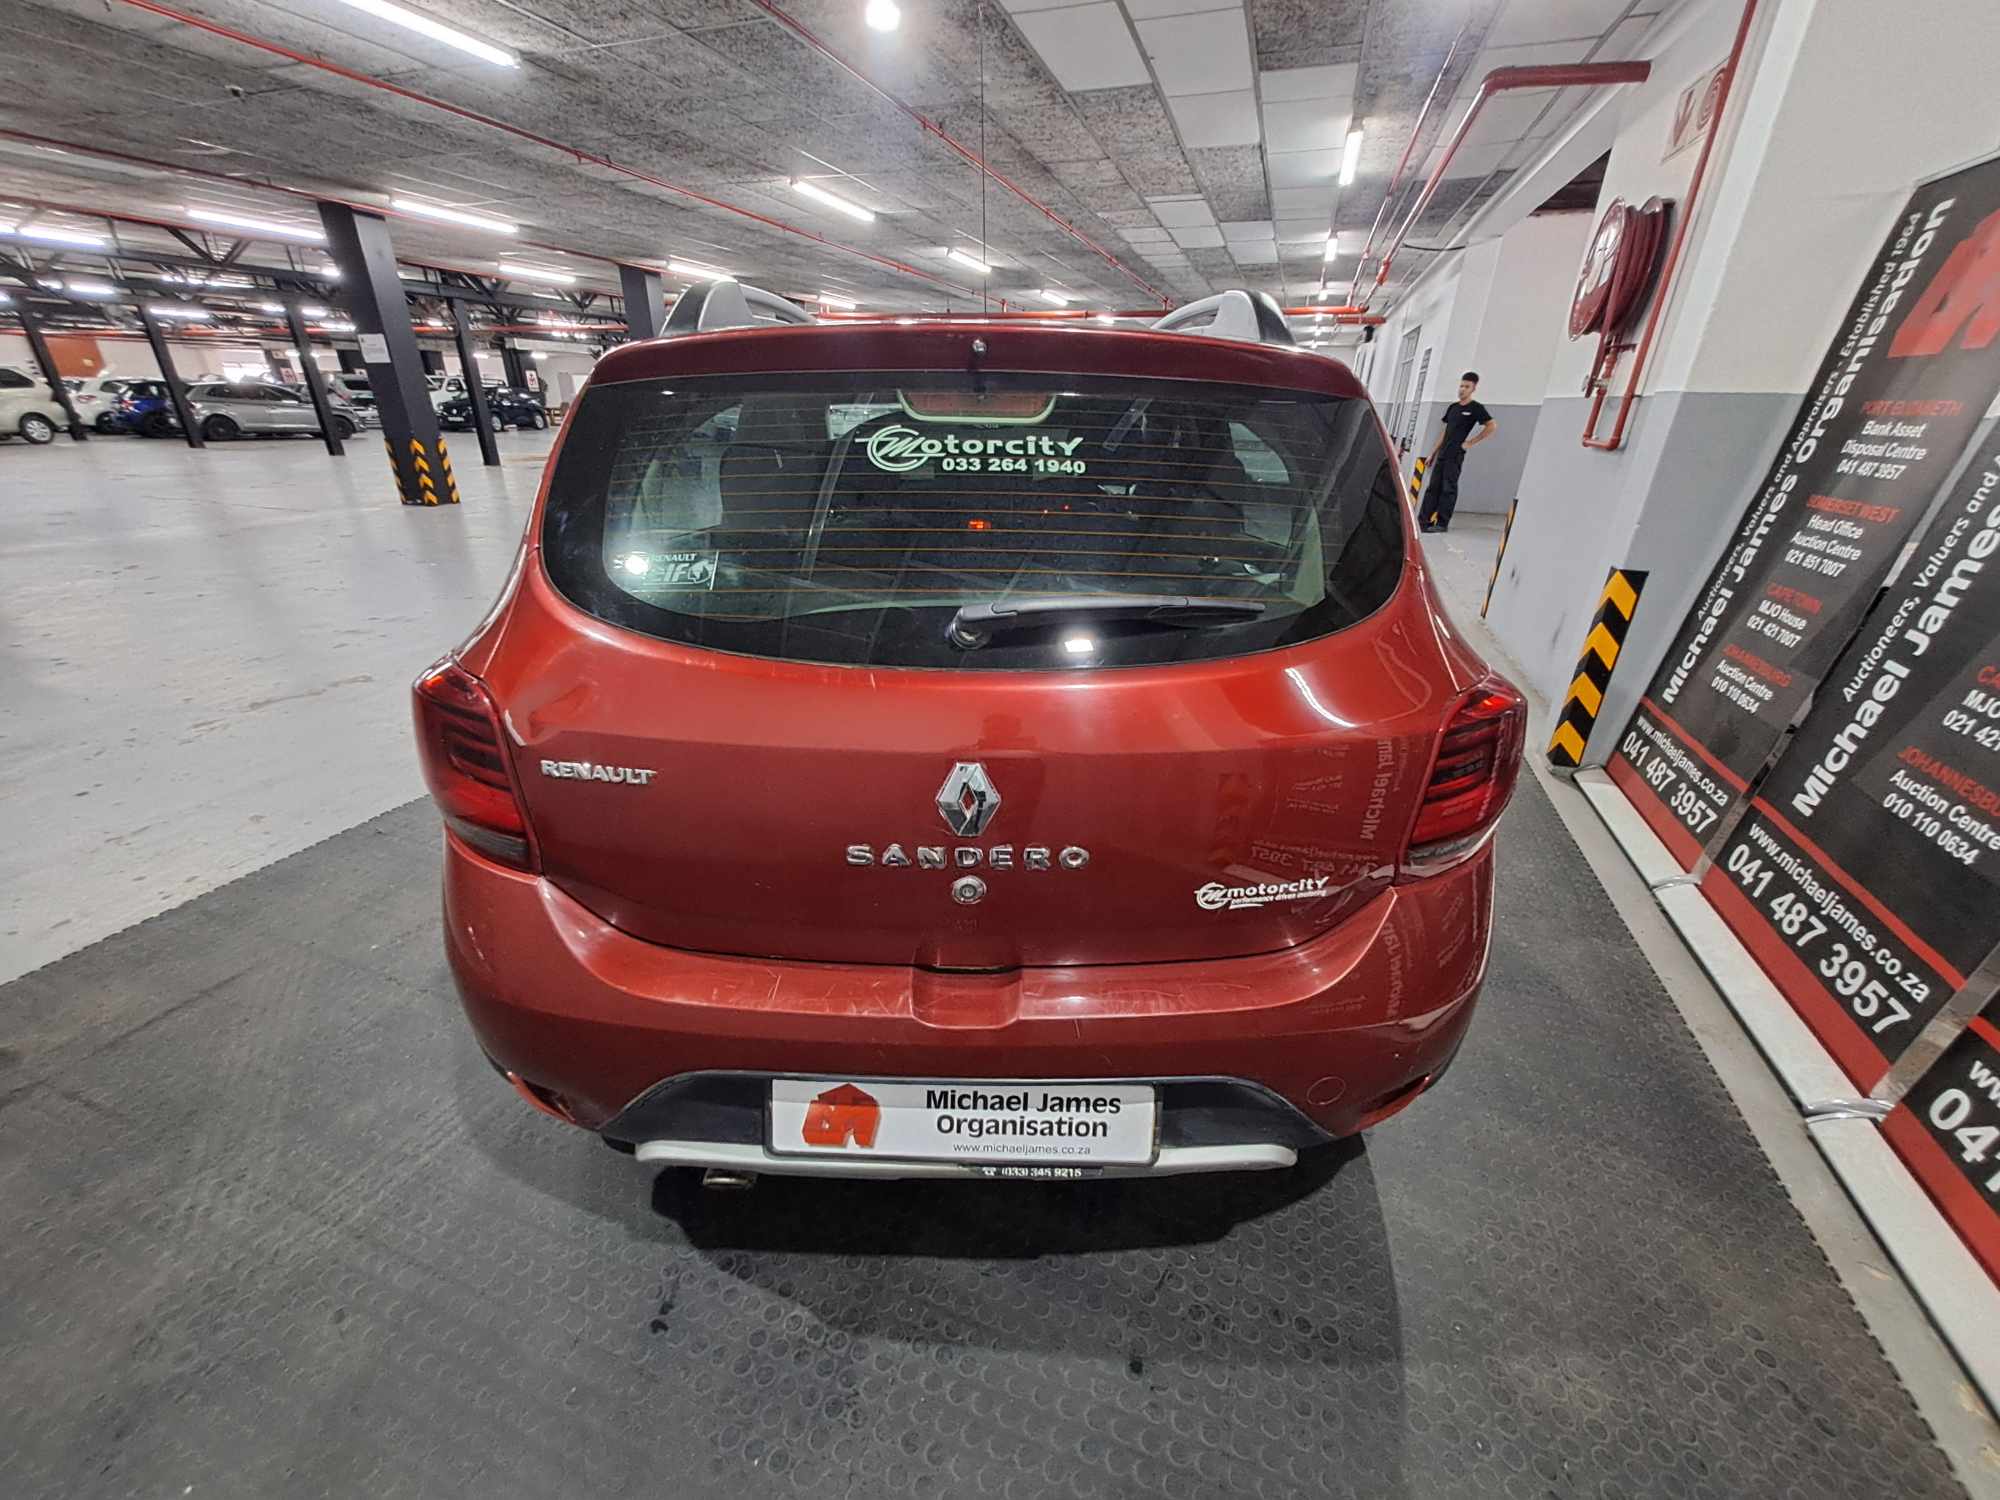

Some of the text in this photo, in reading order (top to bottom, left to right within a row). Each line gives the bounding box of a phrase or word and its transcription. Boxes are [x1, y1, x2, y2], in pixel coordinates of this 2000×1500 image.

[1742, 486, 1775, 536] Valuers
[1774, 453, 1794, 483] and
[1792, 372, 1840, 452] Appraisers
[1840, 262, 1897, 358] Established
[1891, 211, 1923, 257] 1964
[1861, 420, 1927, 438] Bank Asset
[1662, 587, 1734, 704] Michael
[1732, 474, 1799, 583] James
[1796, 198, 1956, 464] Organisation
[1841, 440, 1928, 460] Disposal Centre
[942, 458, 1087, 474] 033 264 1940
[1807, 514, 1837, 532] Head
[1791, 531, 1862, 561] Auction Centre
[1843, 471, 1999, 702] Auctioneers, Valuers and
[1778, 607, 1808, 630] House
[1716, 659, 1747, 684] Auction
[1744, 676, 1774, 701] Centre
[1943, 710, 1977, 735] 021
[1791, 659, 1911, 817] Michael
[540, 759, 656, 785] RENAULT
[1637, 716, 1729, 807] www.michaeljames.co.za
[1623, 731, 1718, 833] 041 487 3957
[1889, 769, 2000, 850] Auction Centre
[1883, 793, 1980, 865] 010 110 0634
[846, 843, 1090, 870] SANDERO
[1227, 876, 1331, 898] motorcity
[1748, 823, 1931, 1003] www.michaeljames.co.za
[1728, 844, 1912, 1034] 041 487 3957
[926, 1089, 1121, 1114] Michael James
[936, 1114, 1109, 1140] Organisation
[953, 1142, 1091, 1157] www.michaeljames.co.za
